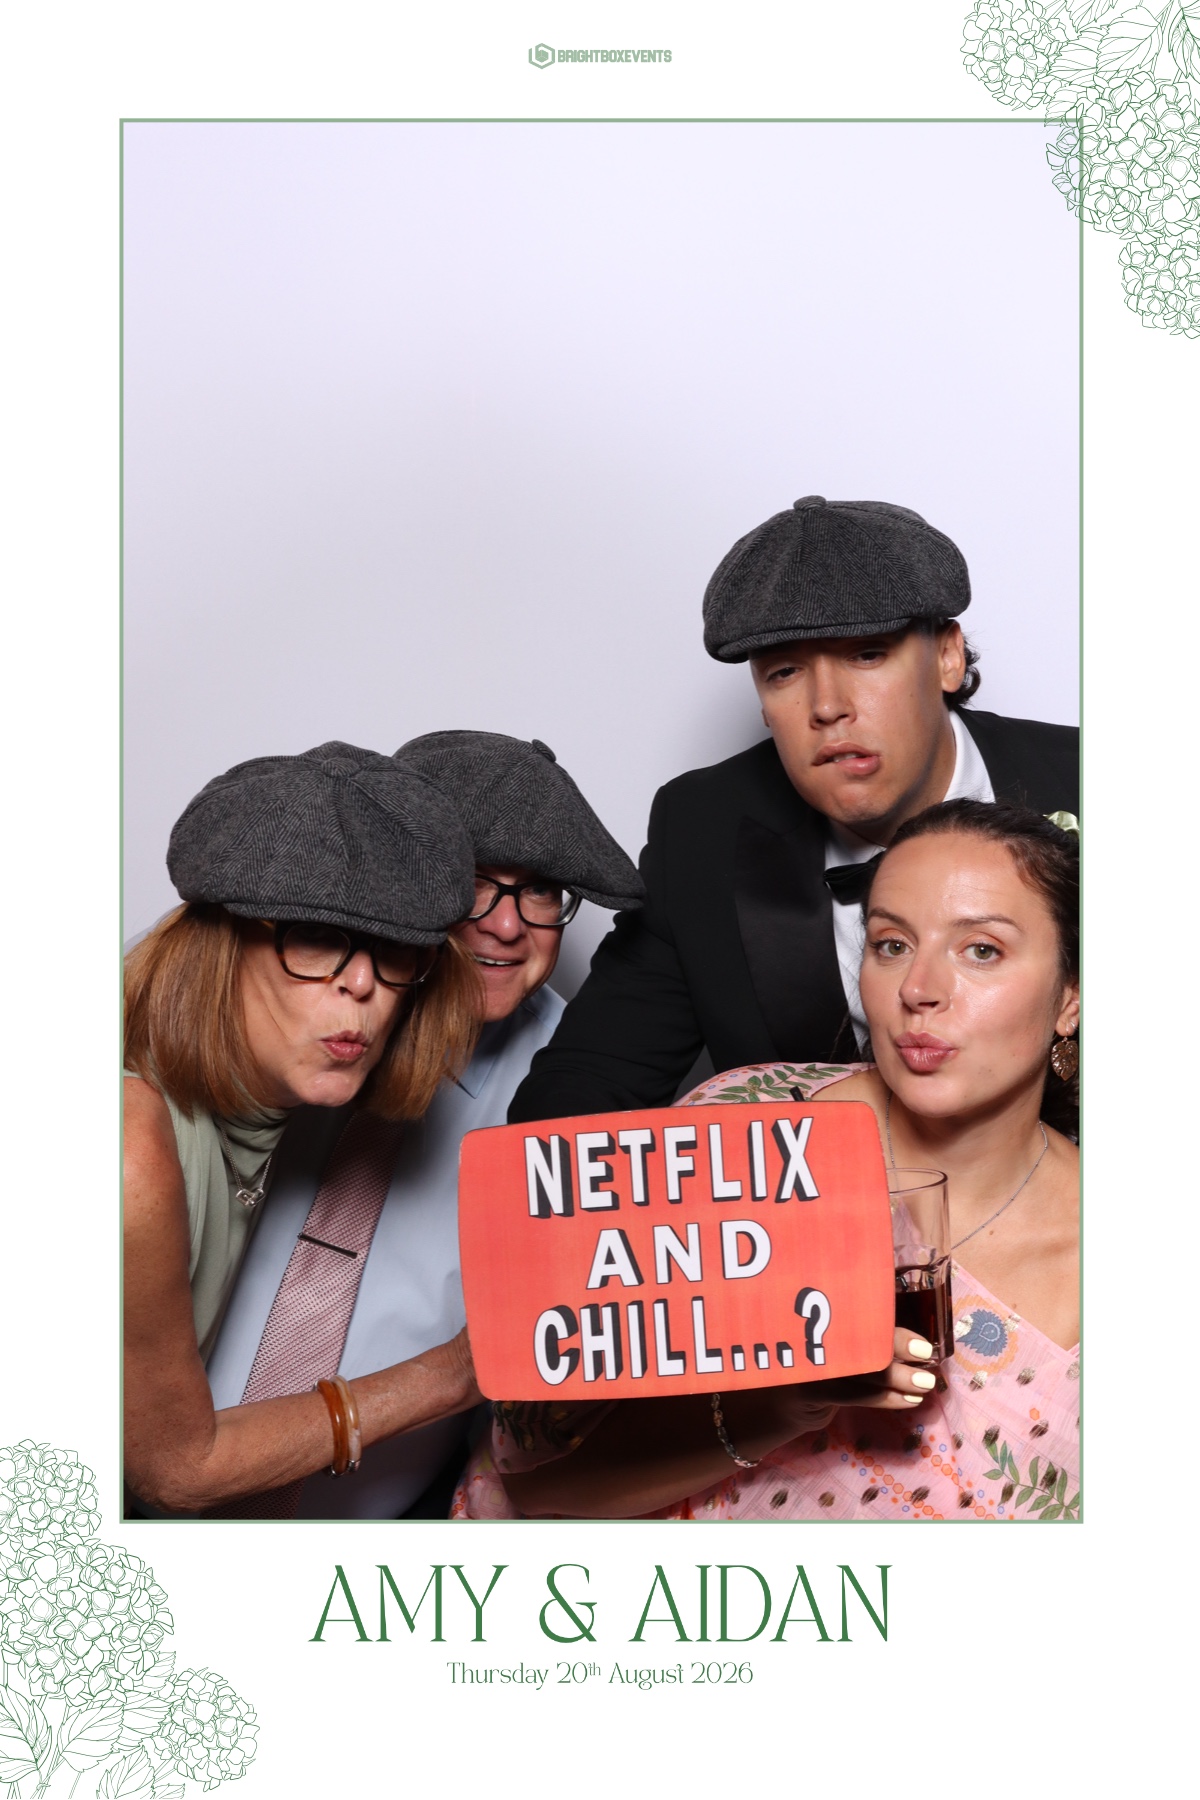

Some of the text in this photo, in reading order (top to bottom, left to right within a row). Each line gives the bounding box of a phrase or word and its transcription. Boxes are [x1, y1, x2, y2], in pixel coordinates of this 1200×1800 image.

[524, 1117, 820, 1219] NETFLIX
[586, 1219, 772, 1290] AND
[533, 1287, 832, 1386] CHILL...?
